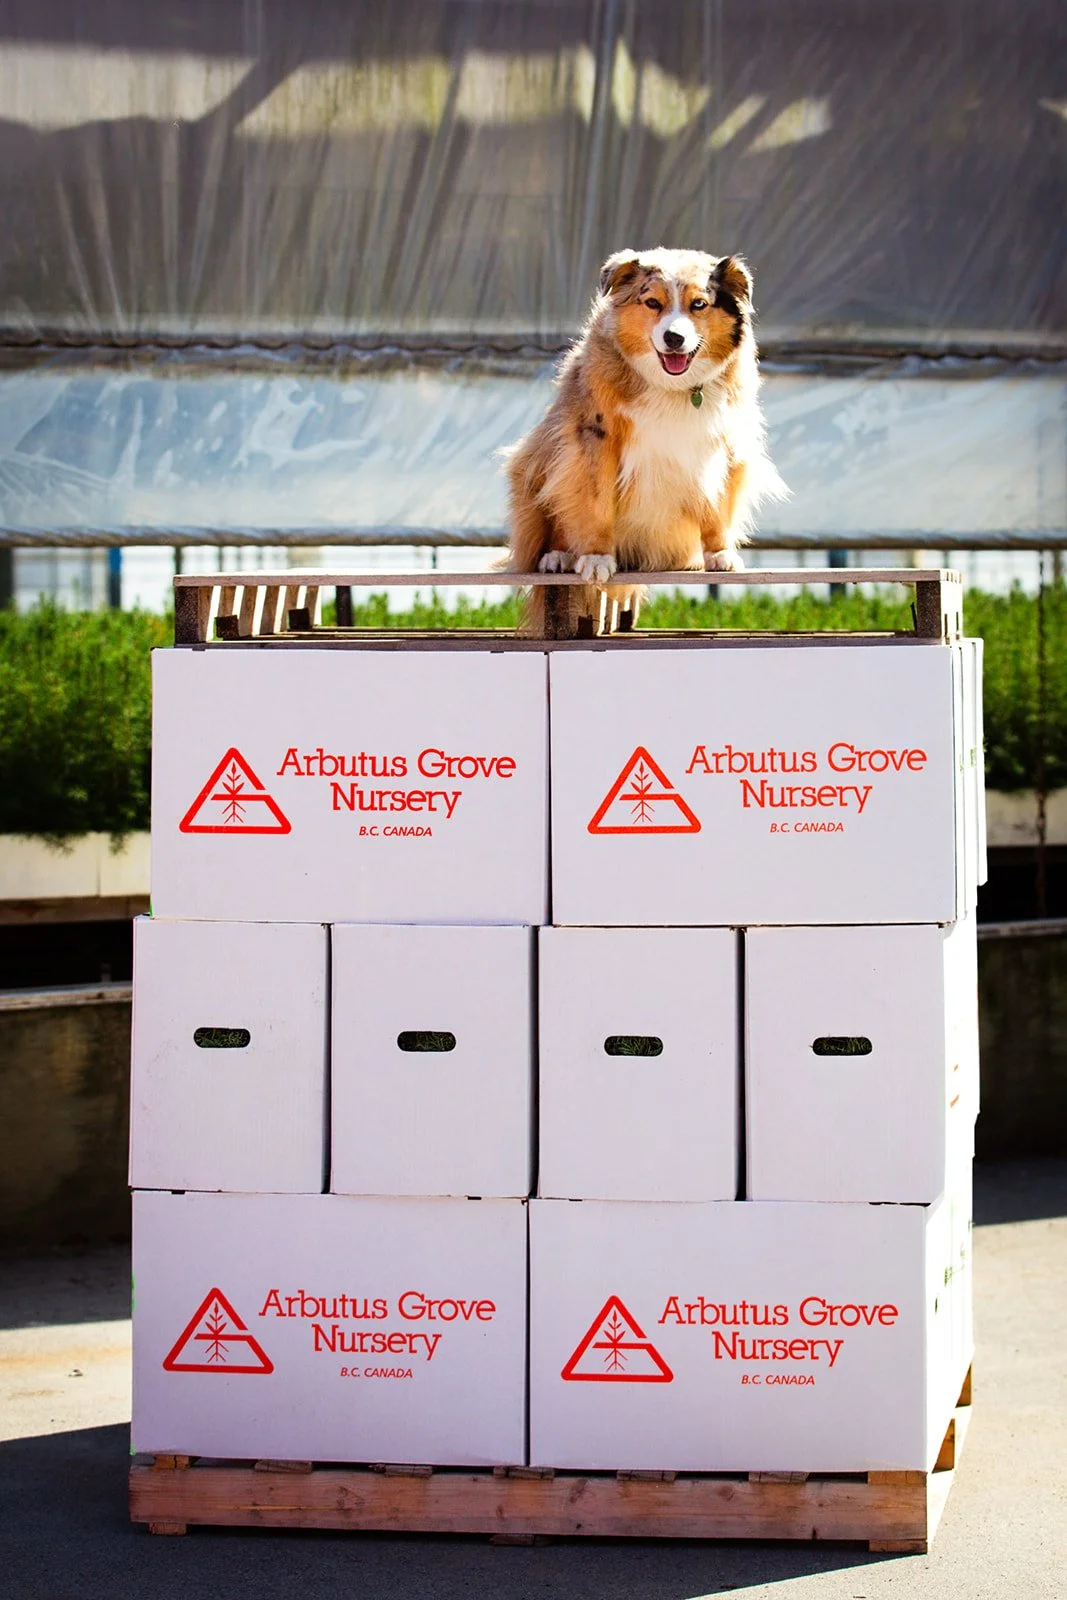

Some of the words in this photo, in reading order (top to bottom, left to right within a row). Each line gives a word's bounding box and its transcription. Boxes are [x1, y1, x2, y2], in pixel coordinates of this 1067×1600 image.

[276, 746, 409, 779] Arbutus
[416, 747, 518, 780] Grove
[684, 743, 819, 775] Arbutus
[826, 741, 929, 774] Grove
[329, 781, 463, 819] Nursery
[738, 778, 874, 815] Nursery
[358, 825, 379, 837] B.C.
[382, 825, 433, 837] CANADA
[769, 821, 791, 833] B.C.
[793, 821, 845, 833] CANADA
[257, 1287, 389, 1321] Arbutus
[397, 1289, 497, 1322] Grove
[657, 1295, 790, 1327] Arbutus
[798, 1295, 900, 1328] Grove
[312, 1322, 443, 1361] Nursery
[711, 1329, 845, 1369] Nursery
[339, 1366, 361, 1378] B.C.
[363, 1367, 413, 1379] CANADA
[740, 1374, 762, 1386] B.C.
[764, 1375, 816, 1386] CANADA
